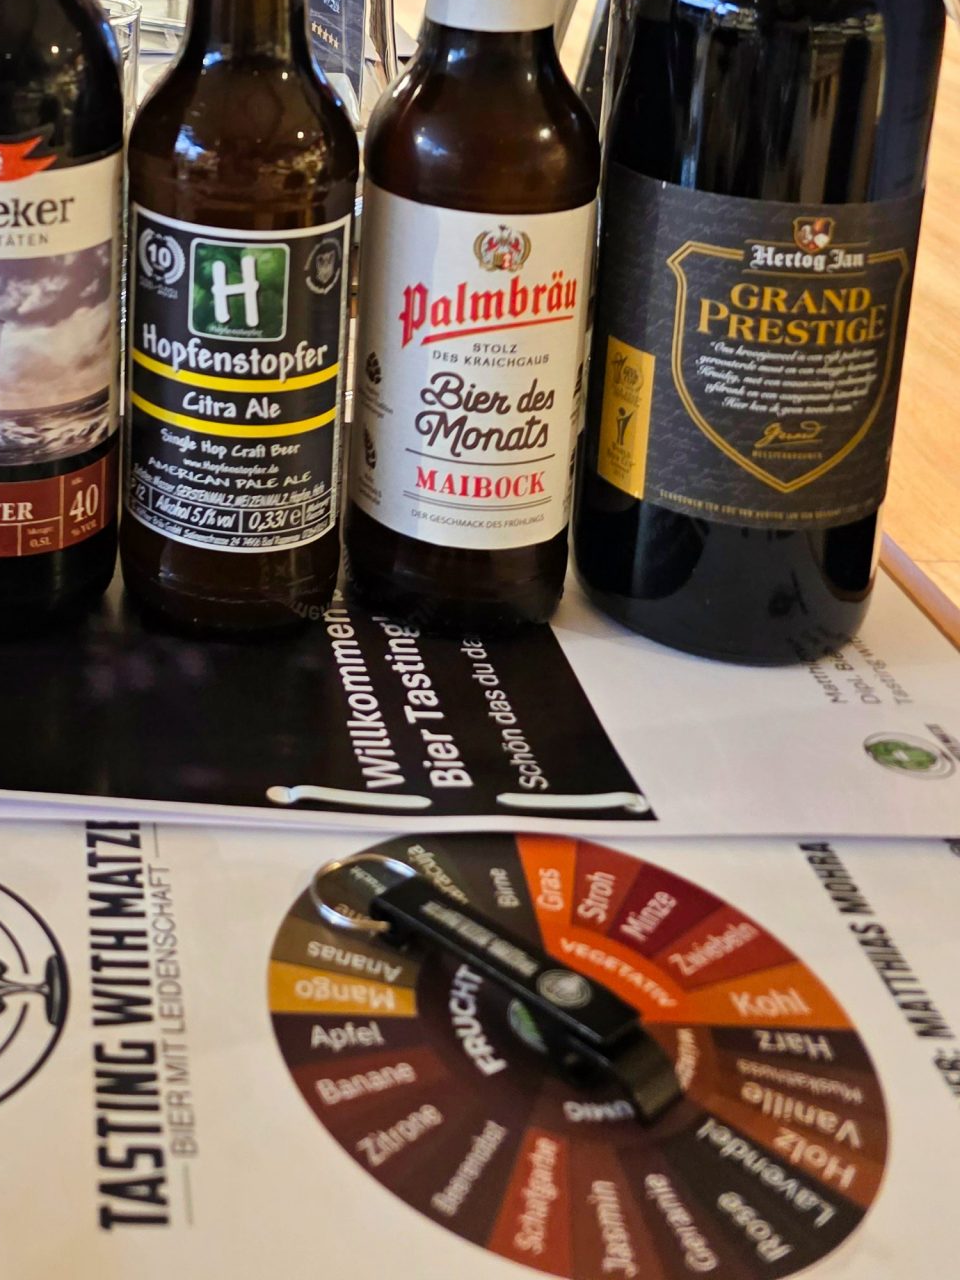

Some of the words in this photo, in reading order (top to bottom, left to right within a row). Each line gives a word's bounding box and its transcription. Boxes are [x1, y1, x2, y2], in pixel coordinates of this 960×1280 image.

[147, 242, 172, 268] 10
[751, 243, 827, 271] Hertog
[827, 248, 865, 270] Jan
[211, 255, 260, 327] H
[399, 271, 578, 349] Palmbräu
[730, 283, 871, 315] GRAND
[696, 297, 887, 346] PRESTIGE
[142, 323, 328, 384] Hopfenstopfer
[432, 350, 459, 364] DES
[464, 354, 550, 368] KRAICHGAUS
[472, 342, 518, 355] STOLZ
[182, 390, 237, 419] Citra
[245, 396, 283, 420] Ale
[421, 371, 511, 414] Bier
[517, 378, 555, 414] des
[160, 427, 197, 453] Single
[200, 439, 227, 460] Hop
[231, 444, 266, 458] Craft
[270, 443, 301, 457] Beer
[415, 413, 549, 457] Monats
[148, 456, 230, 488] AMERICAN
[236, 476, 279, 489] PALE
[283, 471, 313, 488] ALE
[416, 466, 545, 500] MAIBOCK
[429, 514, 485, 529] GESCHMACK
[472, 663, 500, 687] du
[323, 608, 406, 789] Willkommen
[488, 689, 519, 726] das
[423, 729, 475, 789] Bier
[537, 868, 565, 912] Gras
[577, 870, 617, 923] Stroh
[619, 891, 679, 942] Minze
[148, 864, 186, 1038] LEIDENSCHAFT
[307, 940, 404, 983] Ananas
[90, 928, 157, 1028] WITH
[295, 977, 396, 1011] Mango
[850, 921, 955, 1040] MATTHIAS
[449, 964, 509, 1077] FRUCHT
[730, 988, 813, 1017] Kohl
[310, 1021, 386, 1054] Apfel
[754, 1029, 834, 1062] Harz
[164, 1038, 190, 1085] MIT
[315, 1062, 418, 1105] Banane
[94, 1038, 172, 1232] TASTING
[168, 1094, 199, 1157] BIER
[741, 1082, 864, 1149] Vanille
[696, 1118, 838, 1229] Lavendel
[773, 1126, 859, 1189] Holz
[716, 1190, 795, 1264] Rose
